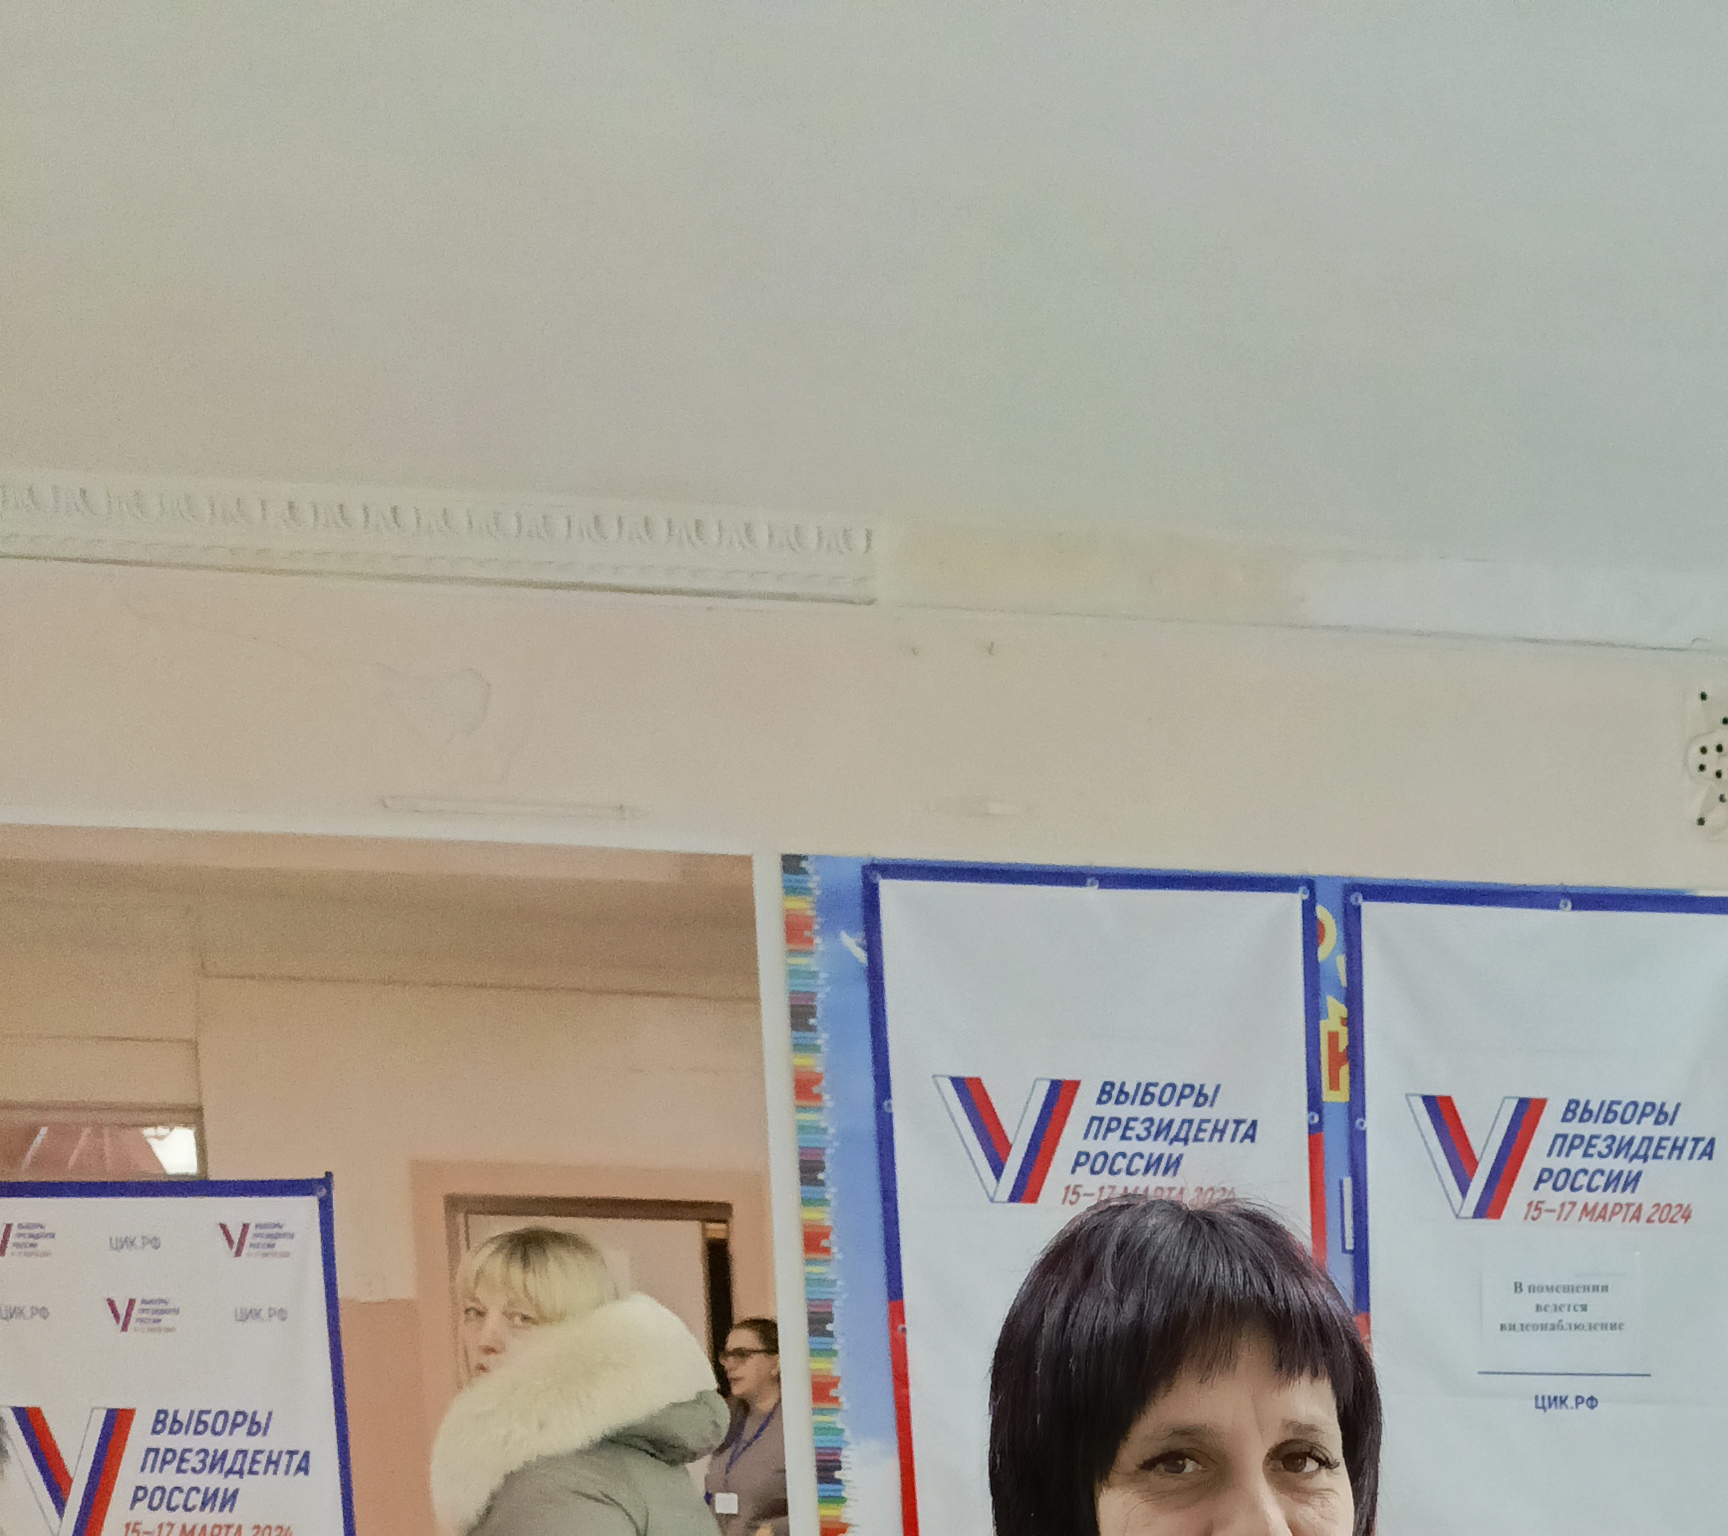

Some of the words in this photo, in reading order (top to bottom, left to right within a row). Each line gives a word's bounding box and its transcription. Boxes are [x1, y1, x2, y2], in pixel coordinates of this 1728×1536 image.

[1096, 1080, 1221, 1109] ВЫБОРЫ
[1560, 1098, 1682, 1126] ВЫБОРЫ
[1083, 1115, 1259, 1147] ПРЕЗИДЕНТА
[1546, 1133, 1716, 1164] ПРЕЗИДЕНТА
[1070, 1150, 1184, 1177] РОССИИ
[1533, 1167, 1643, 1194] РОССИИ
[1577, 1201, 1643, 1223] МАРТА
[1646, 1202, 1693, 1225] 2024
[1513, 1281, 1524, 1294] В
[1527, 1283, 1609, 1294] помещении
[1499, 1319, 1626, 1332] видеонаблюдение
[1534, 1394, 1599, 1413] ЦИК.РФ
[150, 1409, 273, 1437] ВЫБОРЫ
[139, 1447, 311, 1479] ПРЕЗИДЕНТА
[129, 1485, 240, 1513] РОССИИ
